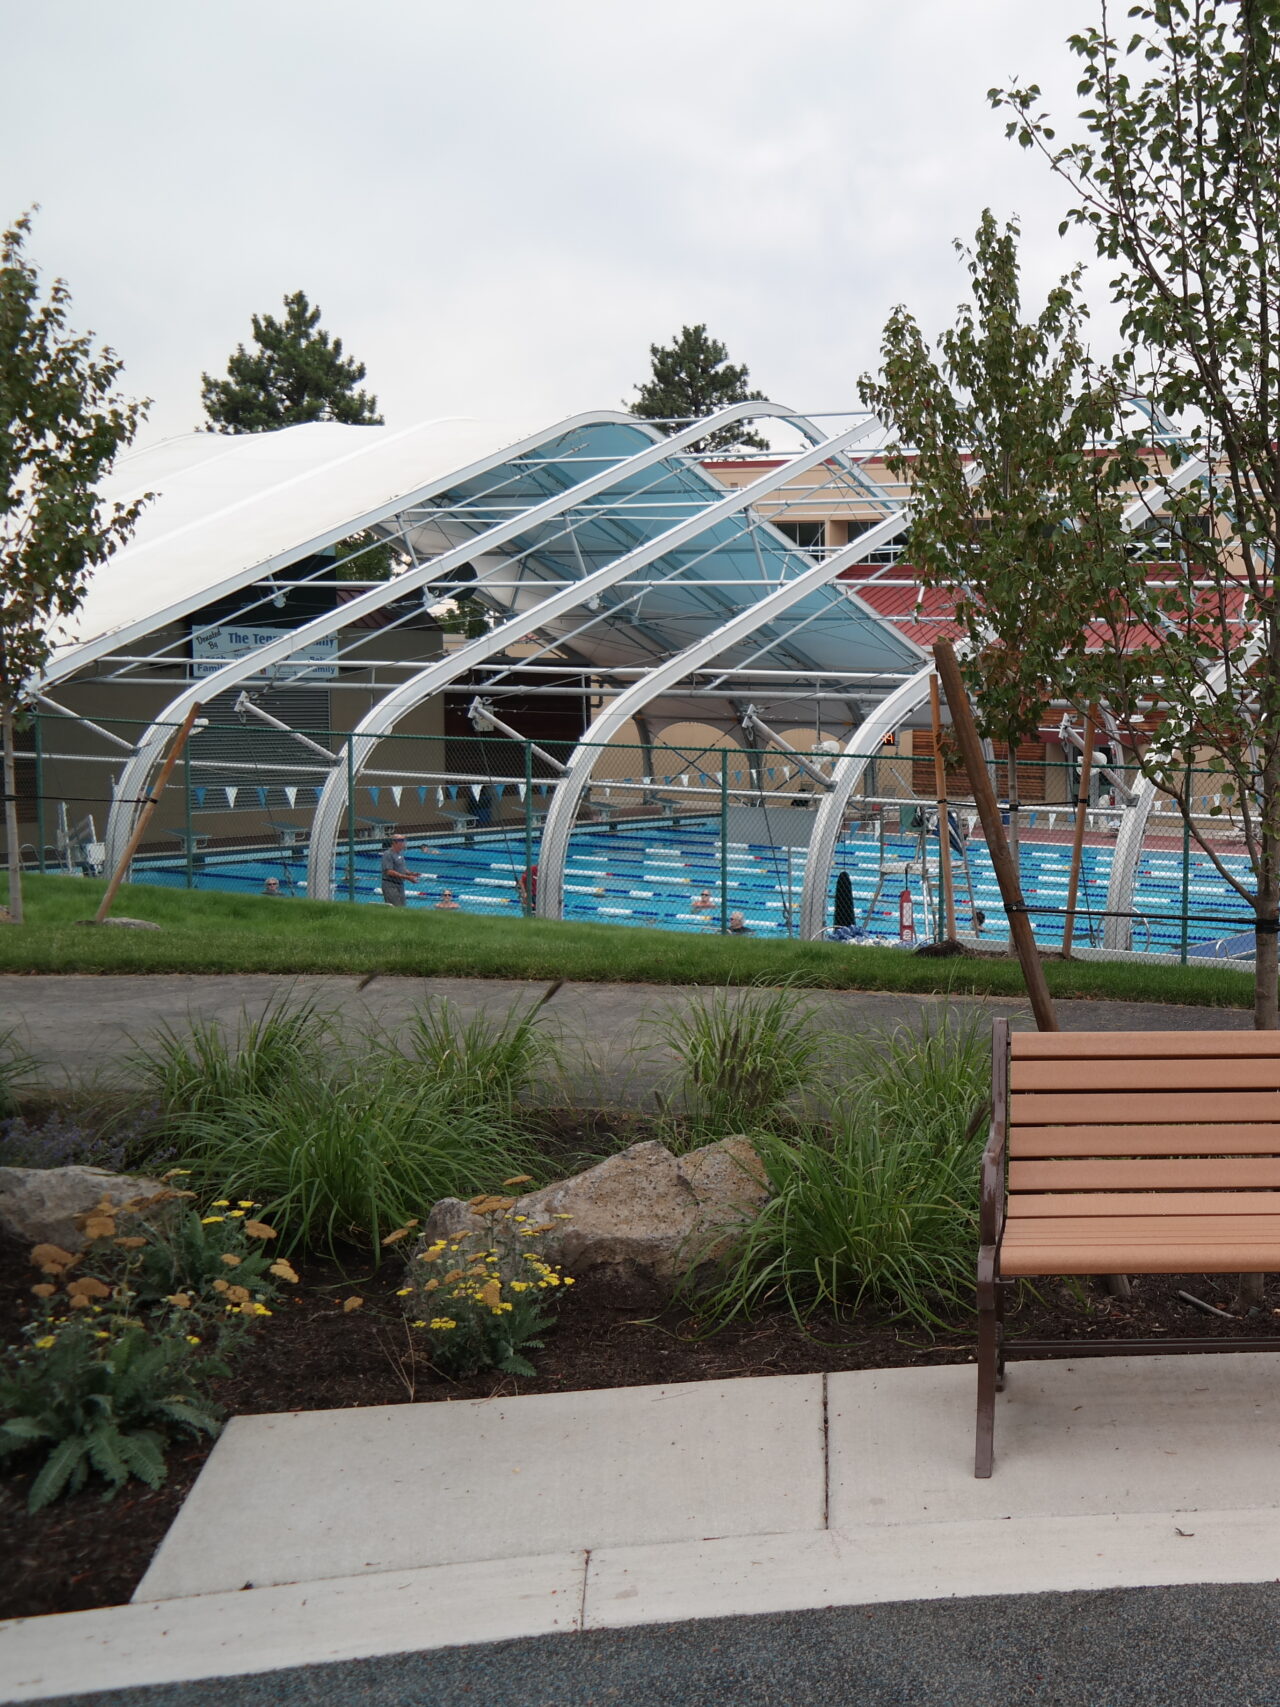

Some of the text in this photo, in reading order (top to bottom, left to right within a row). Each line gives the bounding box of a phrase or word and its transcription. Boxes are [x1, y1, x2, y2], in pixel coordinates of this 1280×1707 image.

[196, 627, 222, 645] Donated
[228, 632, 249, 644] The
[208, 641, 219, 650] By
